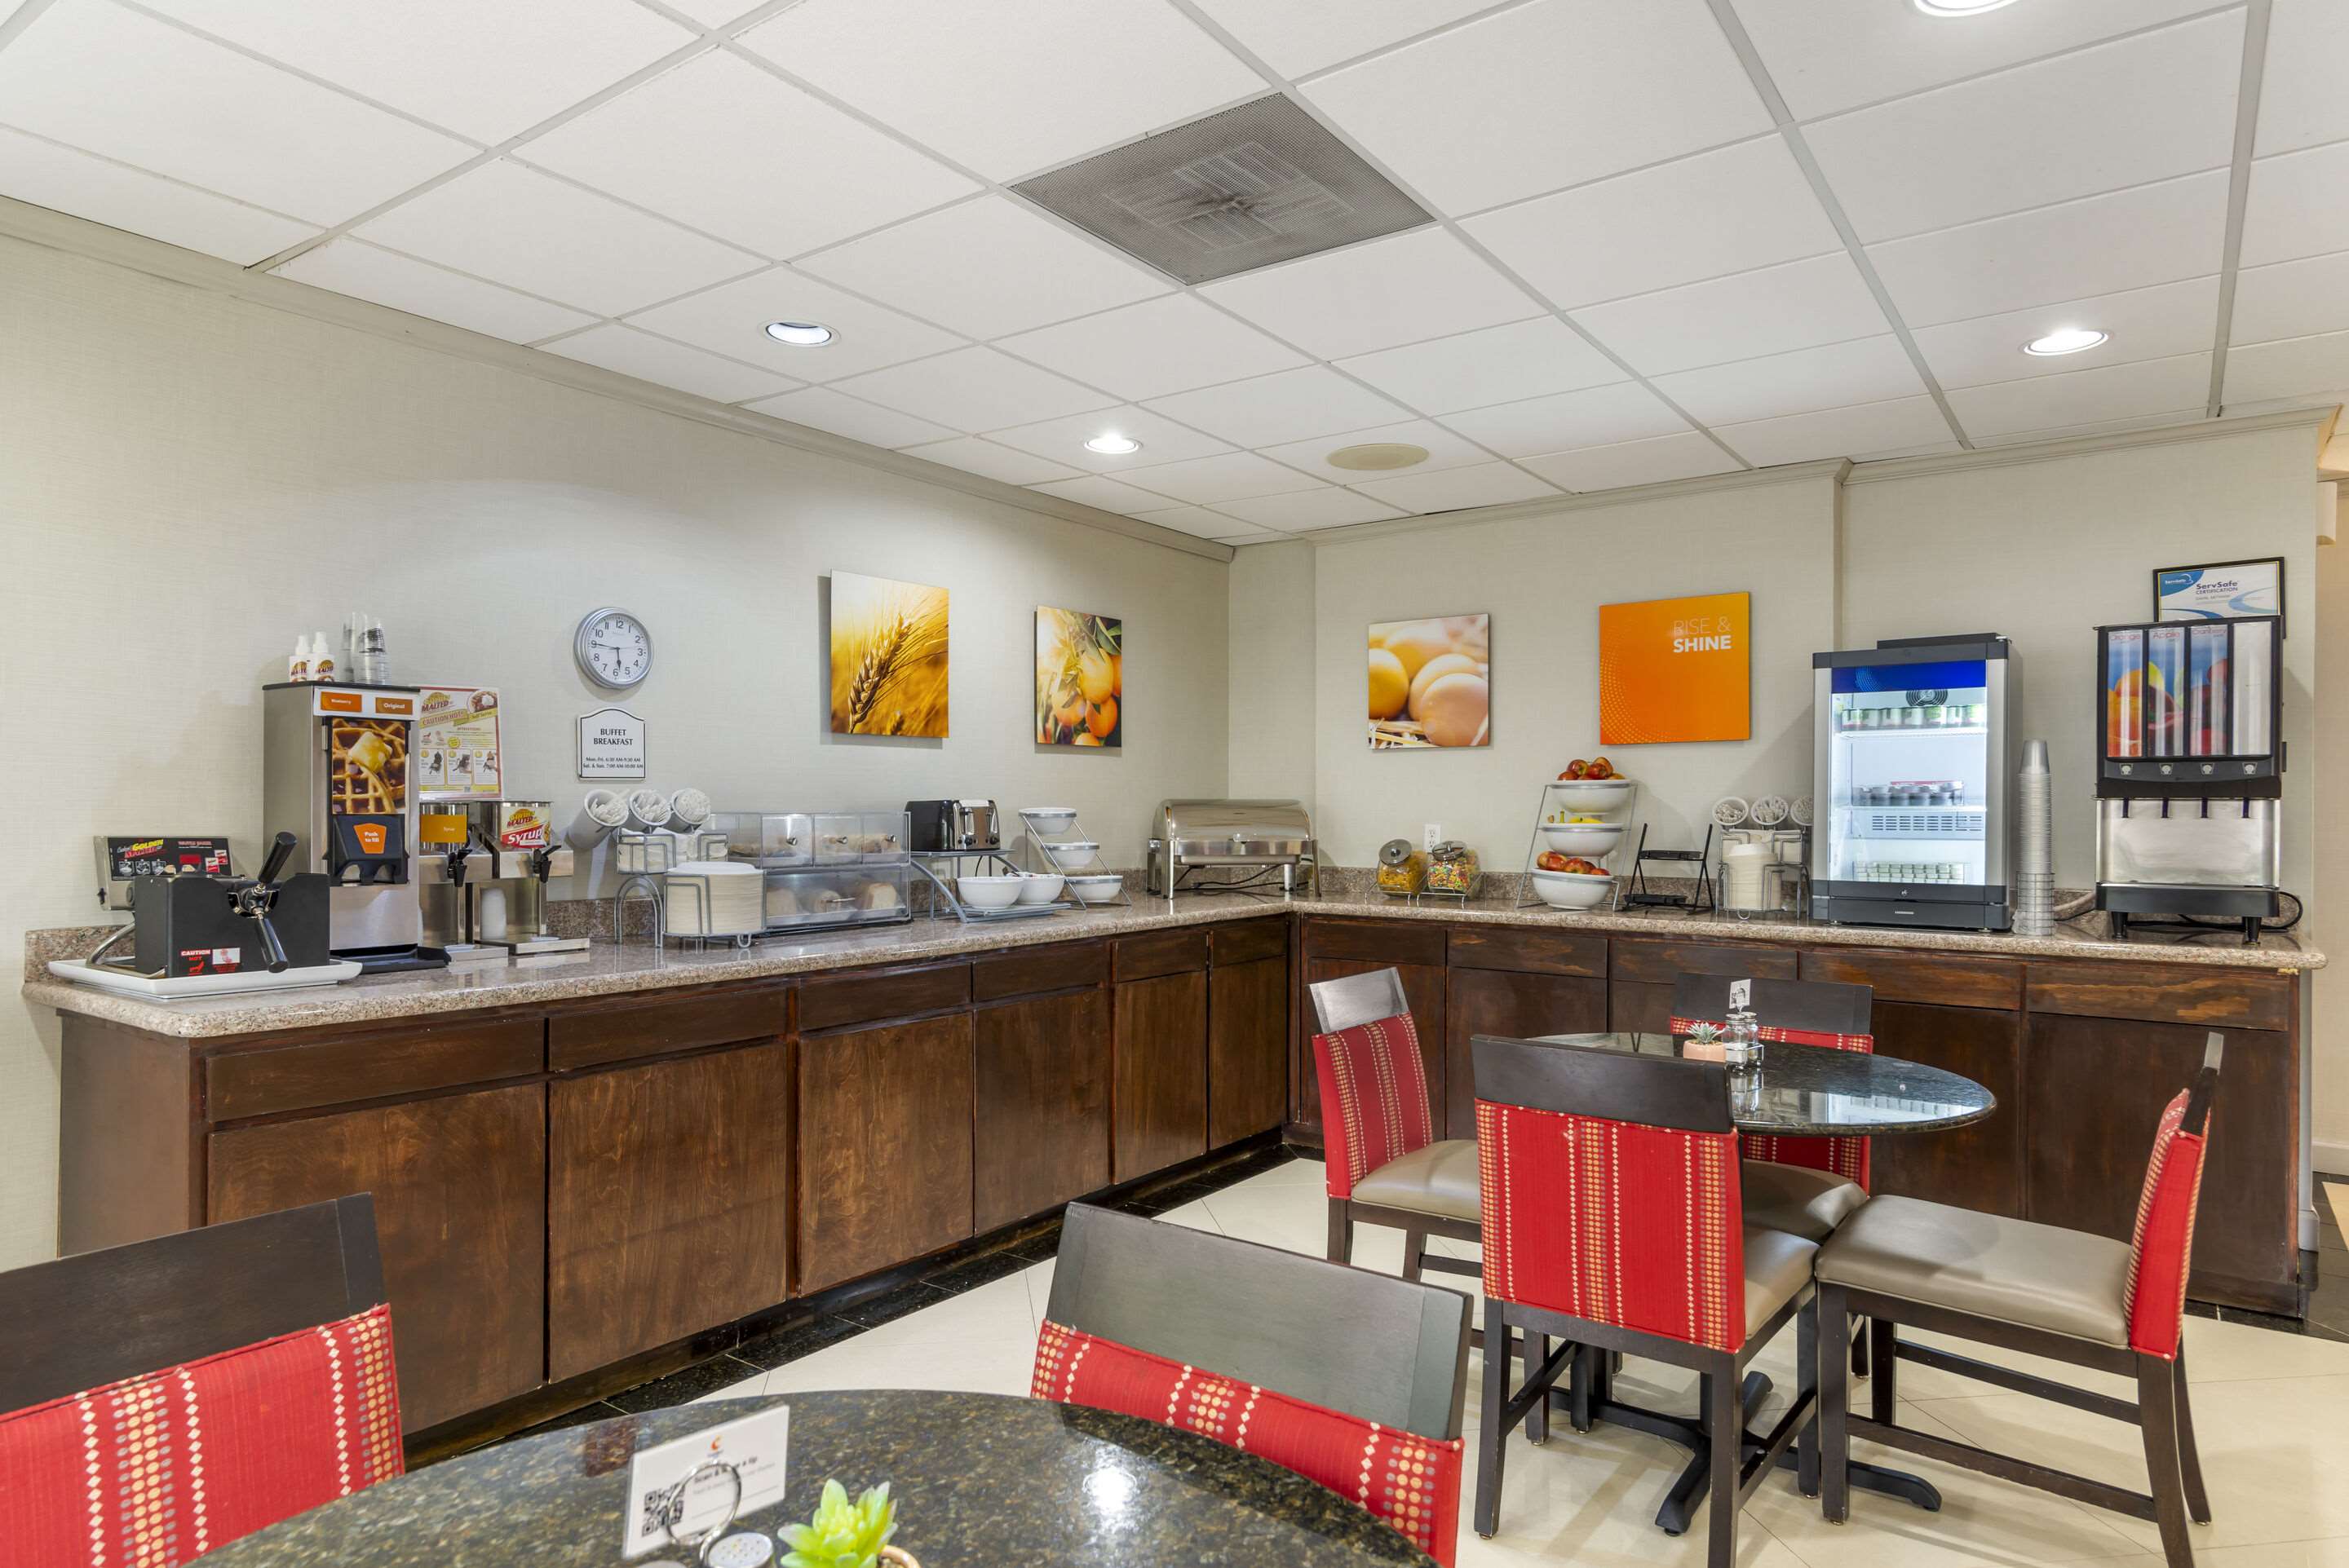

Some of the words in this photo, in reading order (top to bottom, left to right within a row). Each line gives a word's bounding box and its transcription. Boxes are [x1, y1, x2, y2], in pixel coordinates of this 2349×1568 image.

[2196, 581, 2238, 590] ServSafe
[616, 620, 624, 629] 12
[1674, 617, 1710, 634] RISE
[1718, 616, 1731, 632] &
[595, 629, 604, 638] 10
[635, 635, 641, 643] 2
[591, 640, 597, 648] 9
[1674, 635, 1732, 653] SHINE
[637, 648, 644, 656] 3
[594, 653, 599, 661] 8
[625, 667, 630, 675] 5
[507, 827, 543, 845] Syrup
[132, 839, 163, 851] GOLDEN
